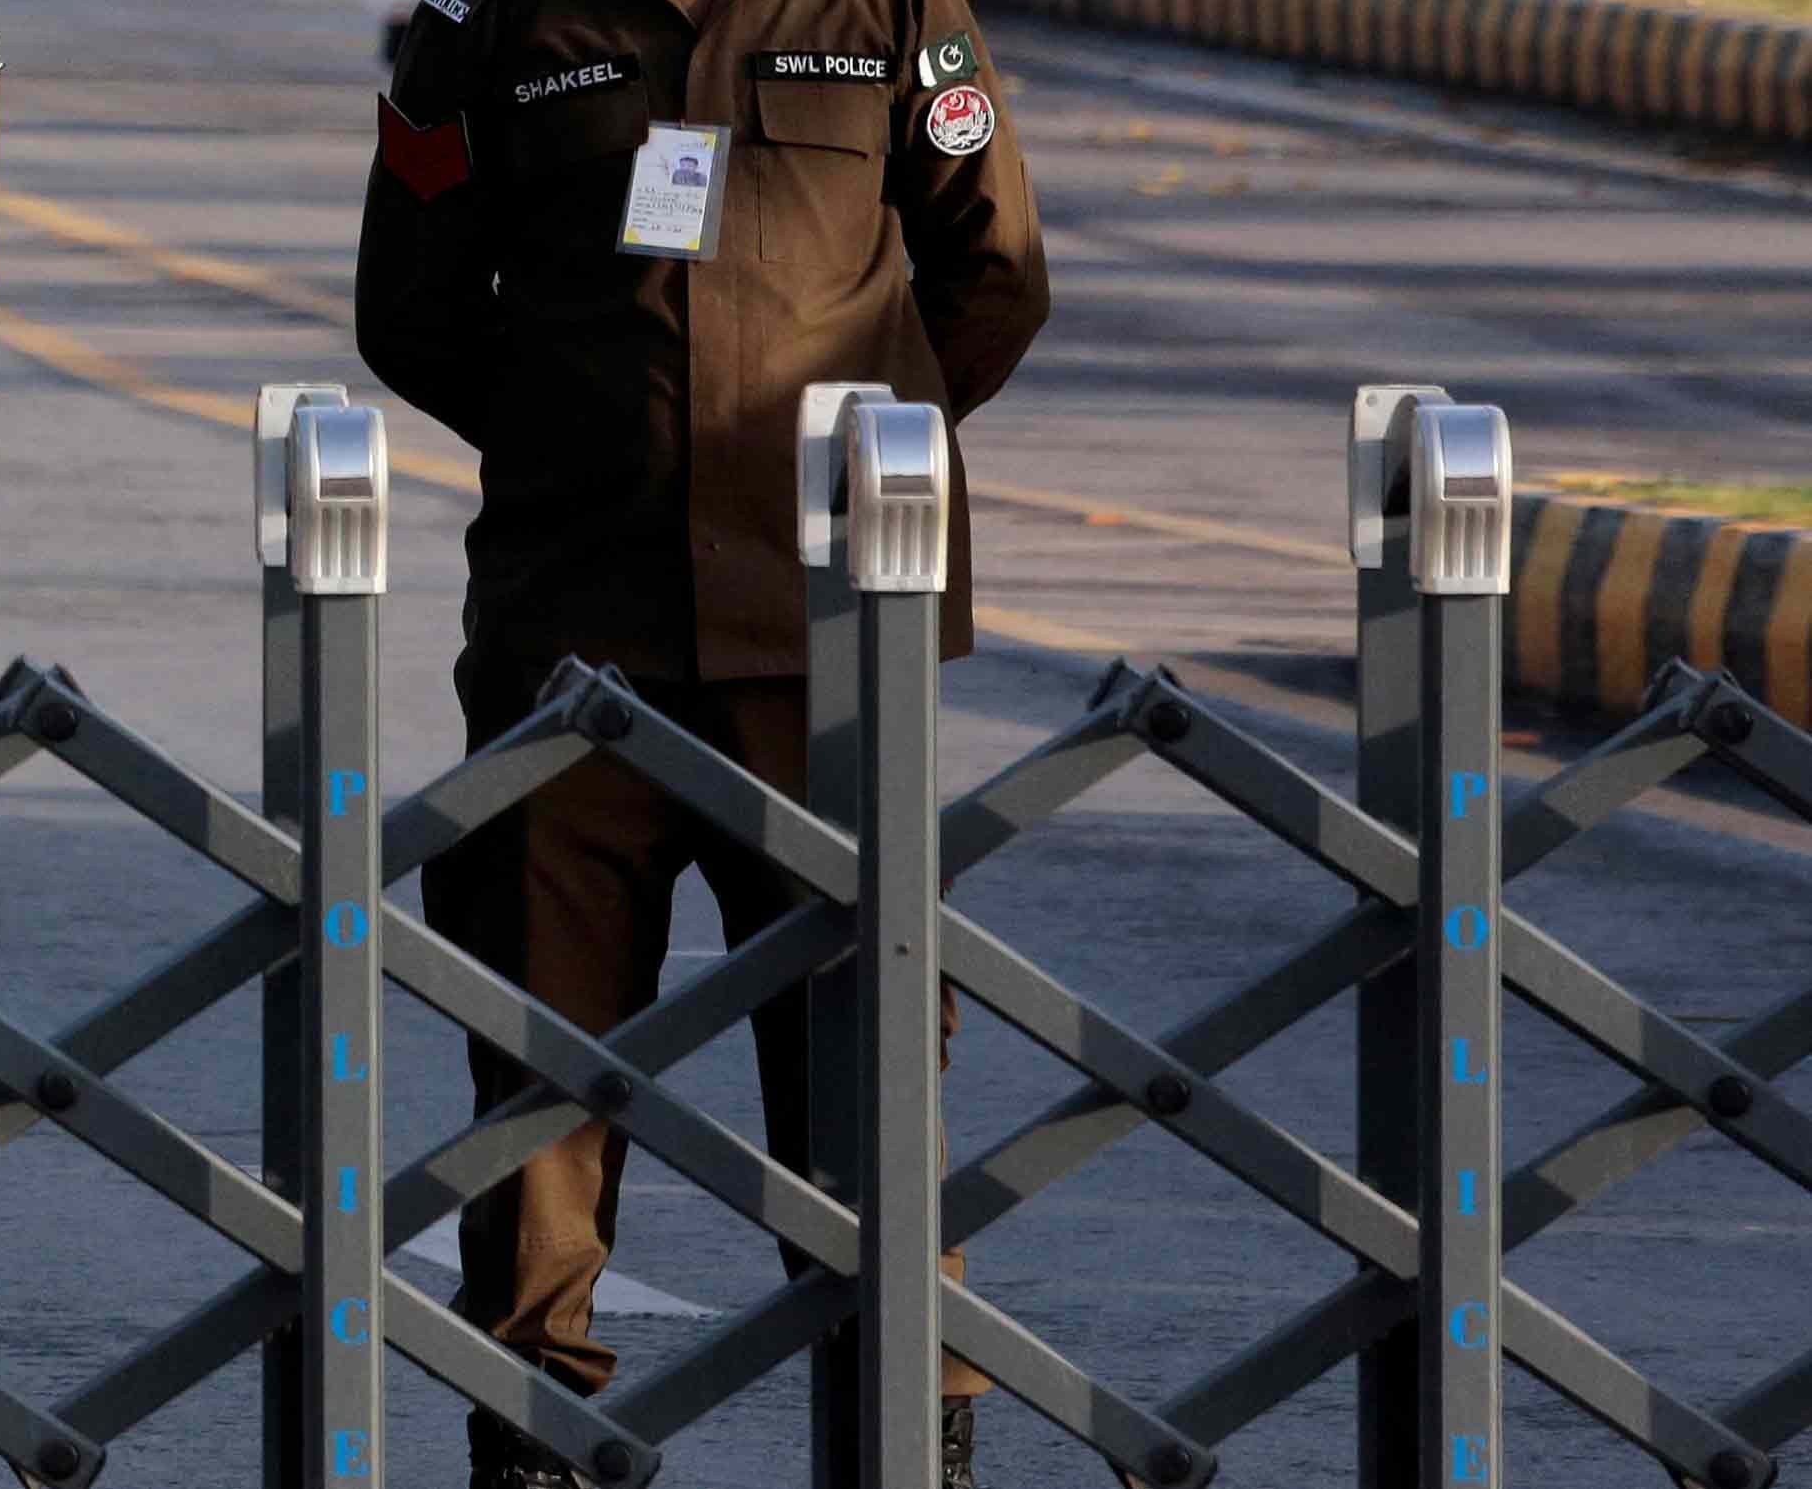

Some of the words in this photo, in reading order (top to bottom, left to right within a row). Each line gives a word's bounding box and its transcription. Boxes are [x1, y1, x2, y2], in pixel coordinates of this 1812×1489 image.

[514, 62, 623, 103] SHAKEEL
[775, 55, 820, 74] SWL
[825, 56, 886, 79] POLICE
[323, 770, 369, 1477] POLICE
[1443, 771, 1489, 1482] POLICE
